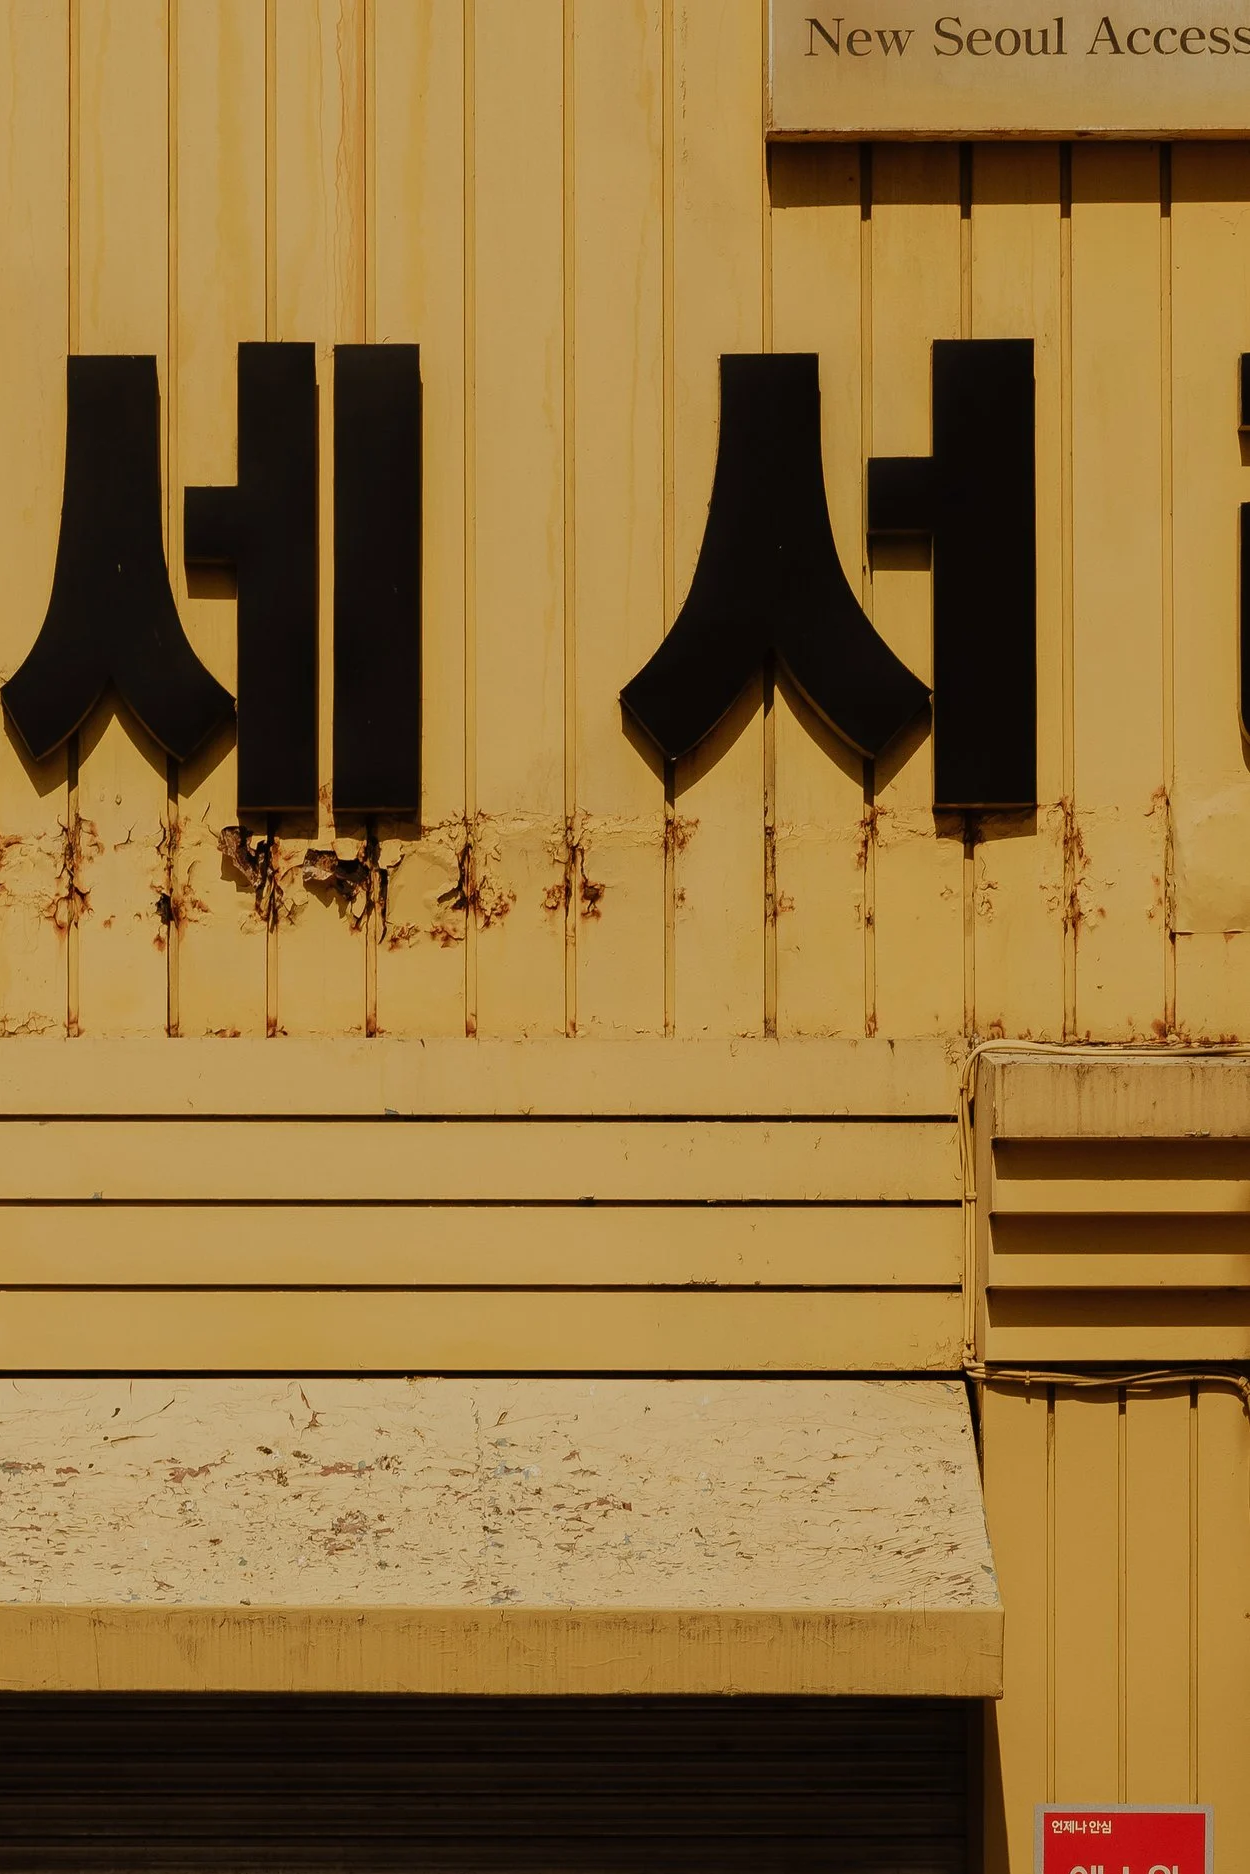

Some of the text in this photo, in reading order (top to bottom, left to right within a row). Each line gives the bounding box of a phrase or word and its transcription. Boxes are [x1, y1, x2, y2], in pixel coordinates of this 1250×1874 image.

[805, 15, 1250, 57] New Seoul Access
[1051, 1820, 1112, 1834] 언제나 안심
